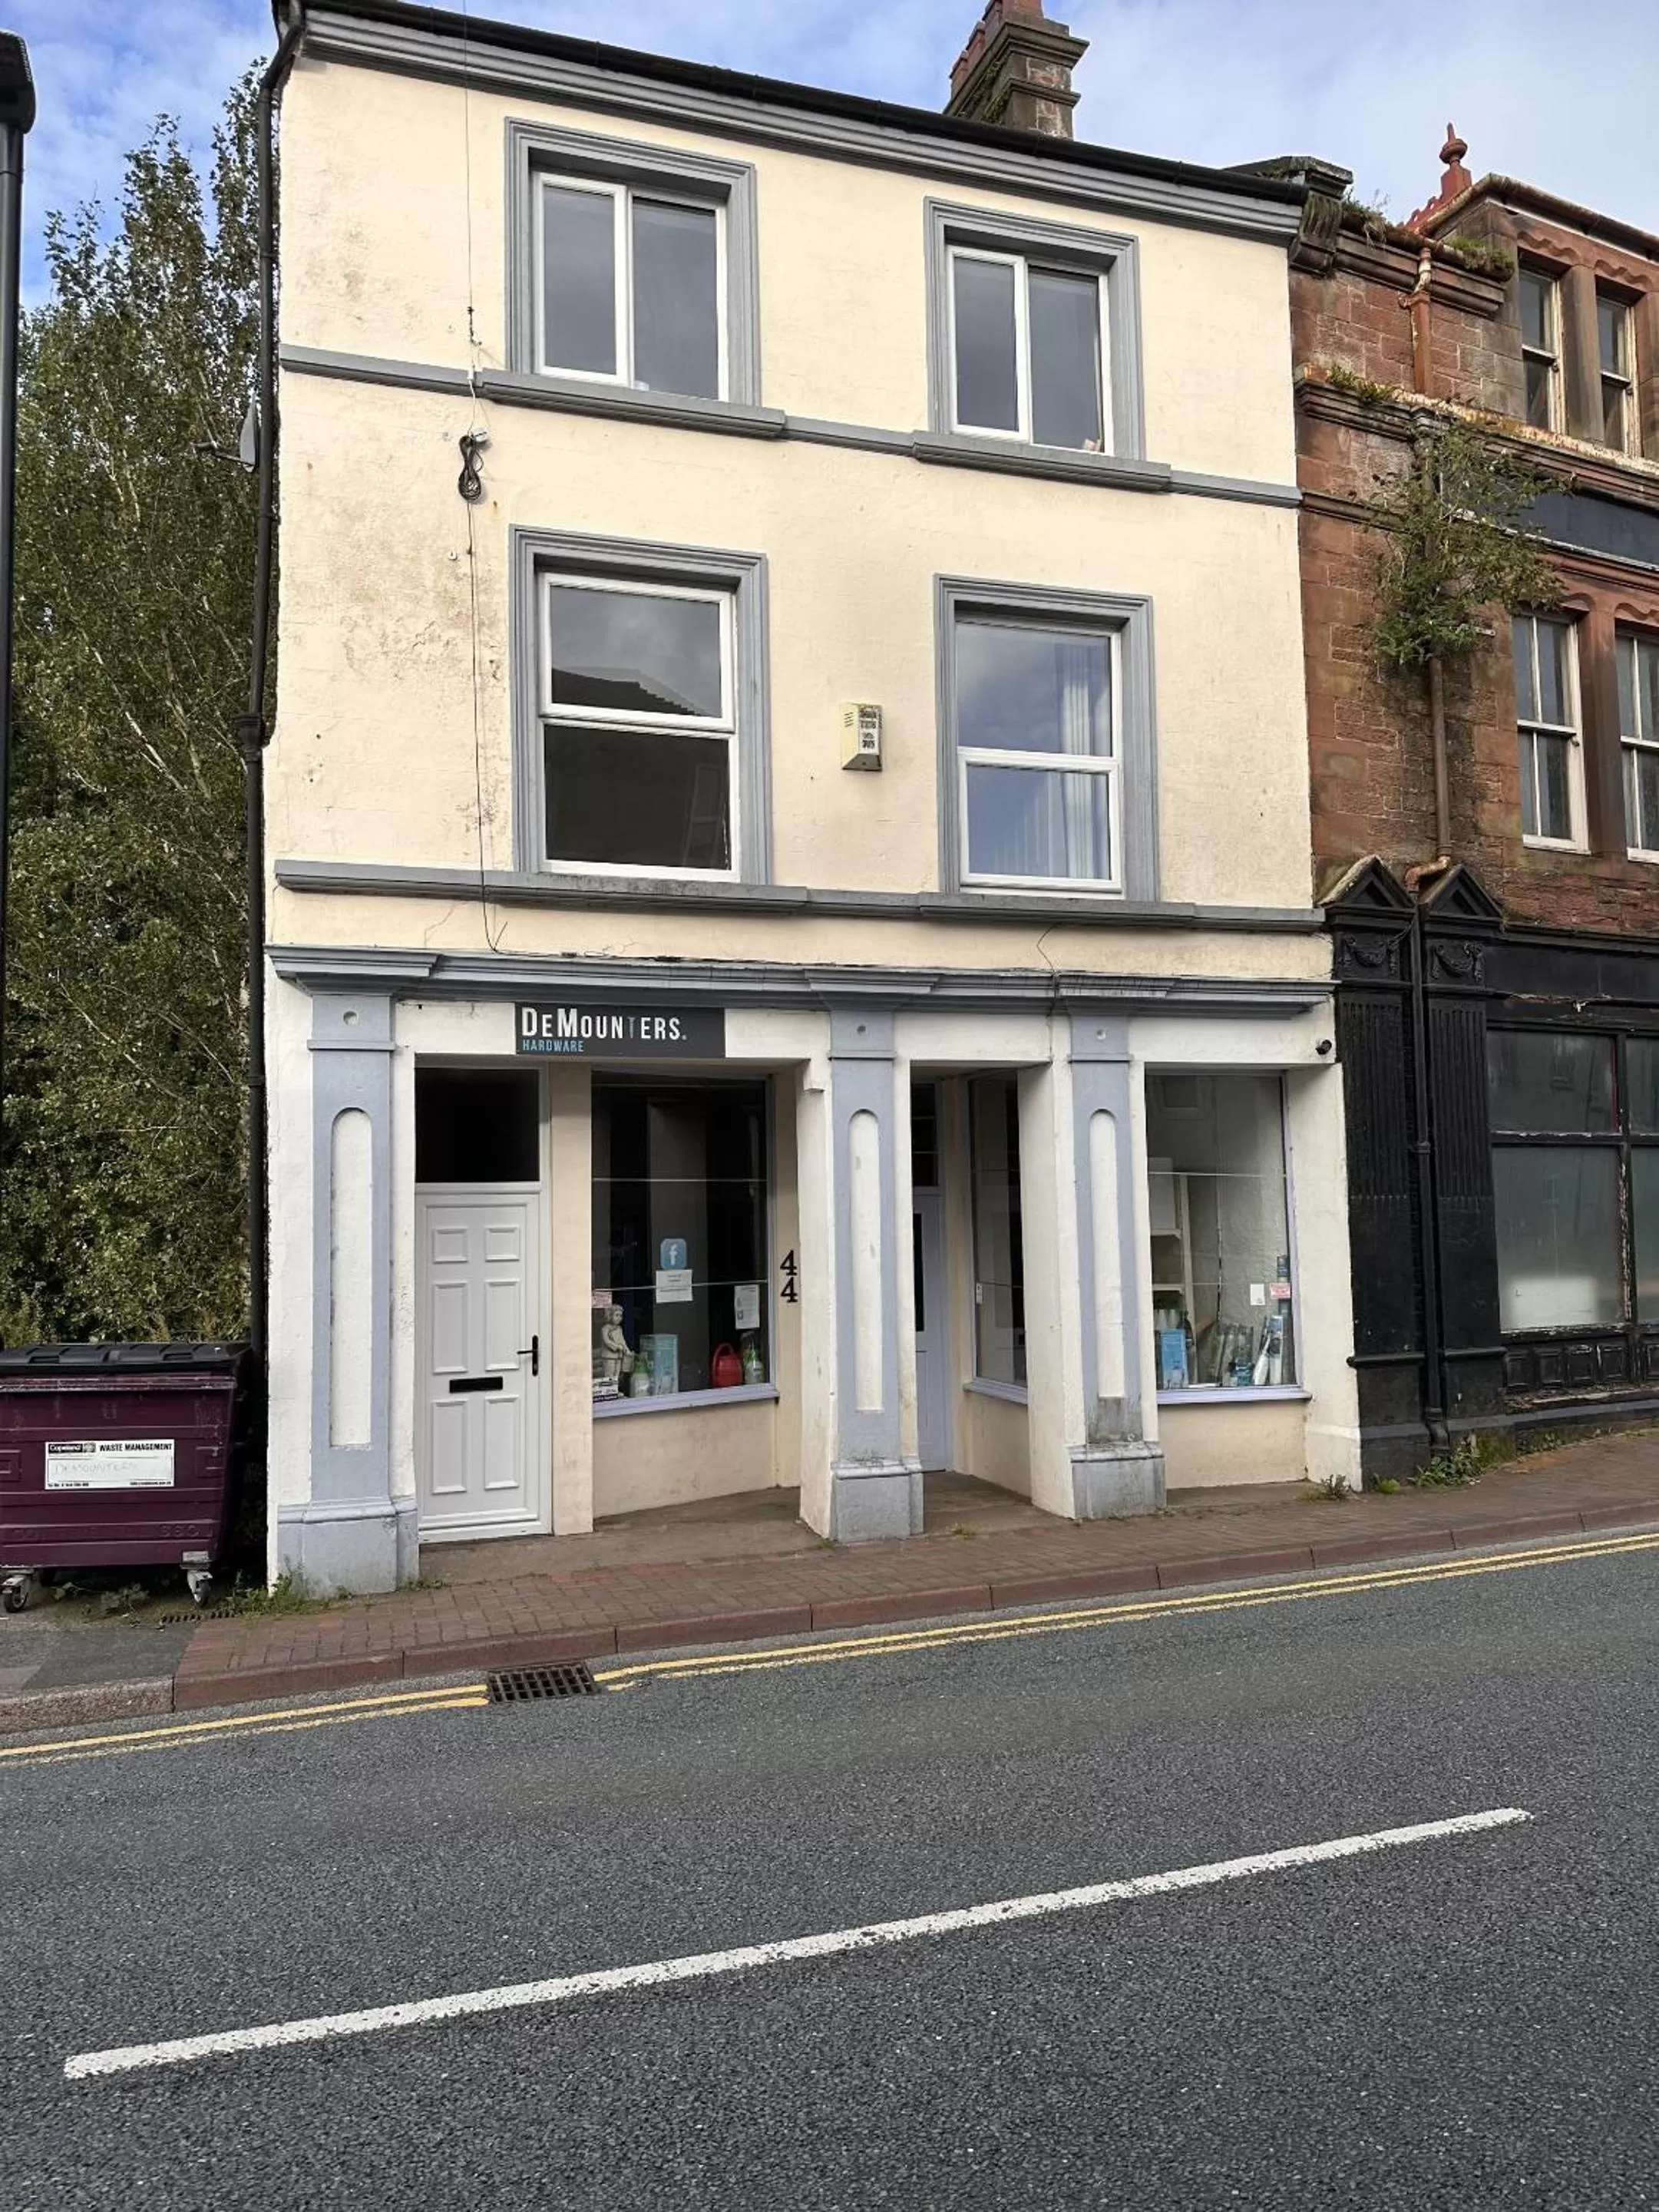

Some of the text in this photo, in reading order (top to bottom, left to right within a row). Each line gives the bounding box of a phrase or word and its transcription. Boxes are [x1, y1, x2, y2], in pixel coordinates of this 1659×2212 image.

[522, 1039, 585, 1053] HARDWARE
[99, 1443, 173, 1452] WASTE MANAGEMENT
